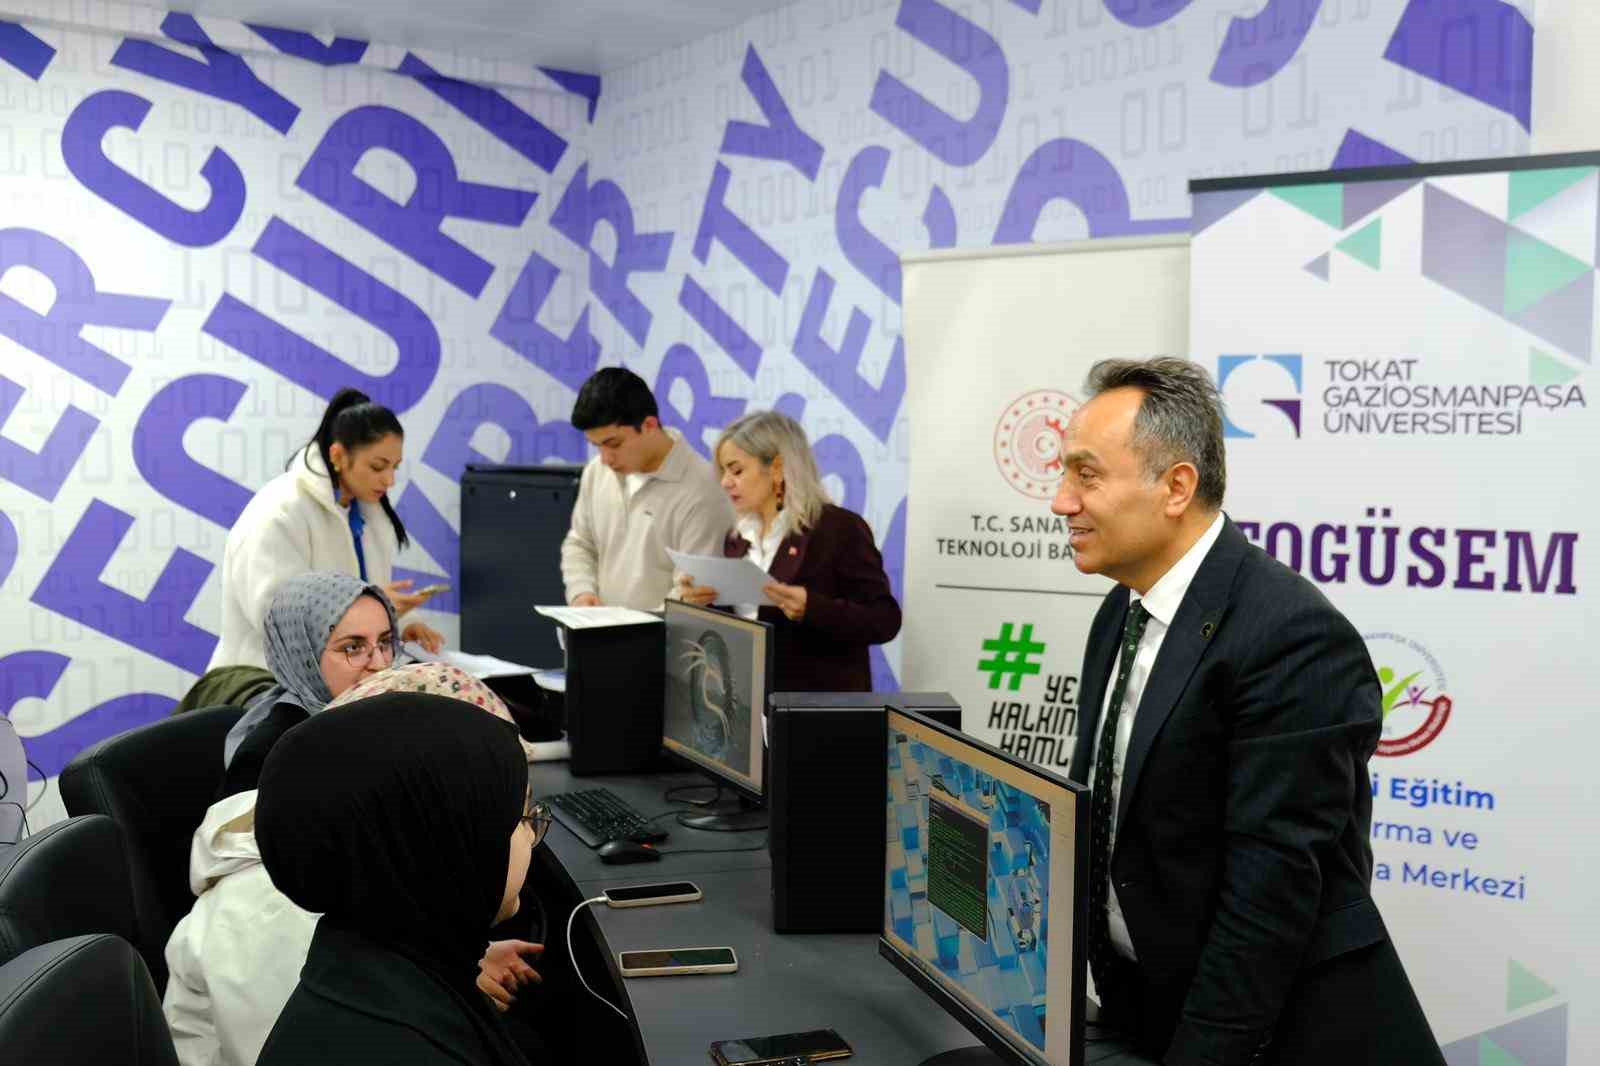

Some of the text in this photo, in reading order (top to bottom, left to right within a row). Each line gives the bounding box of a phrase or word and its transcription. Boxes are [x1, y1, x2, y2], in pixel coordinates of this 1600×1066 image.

[1323, 359, 1418, 382] TOKAT
[1323, 383, 1587, 411] GAZİOSMANPAŞA
[1323, 409, 1523, 435] ÜNİVERSİTESİ
[971, 514, 1004, 533] T.C.
[936, 538, 1042, 560] TEKNOLOJİ
[1389, 777, 1496, 811] Eğitim
[1443, 829, 1479, 850] ve
[1402, 861, 1527, 901] Merkezi
